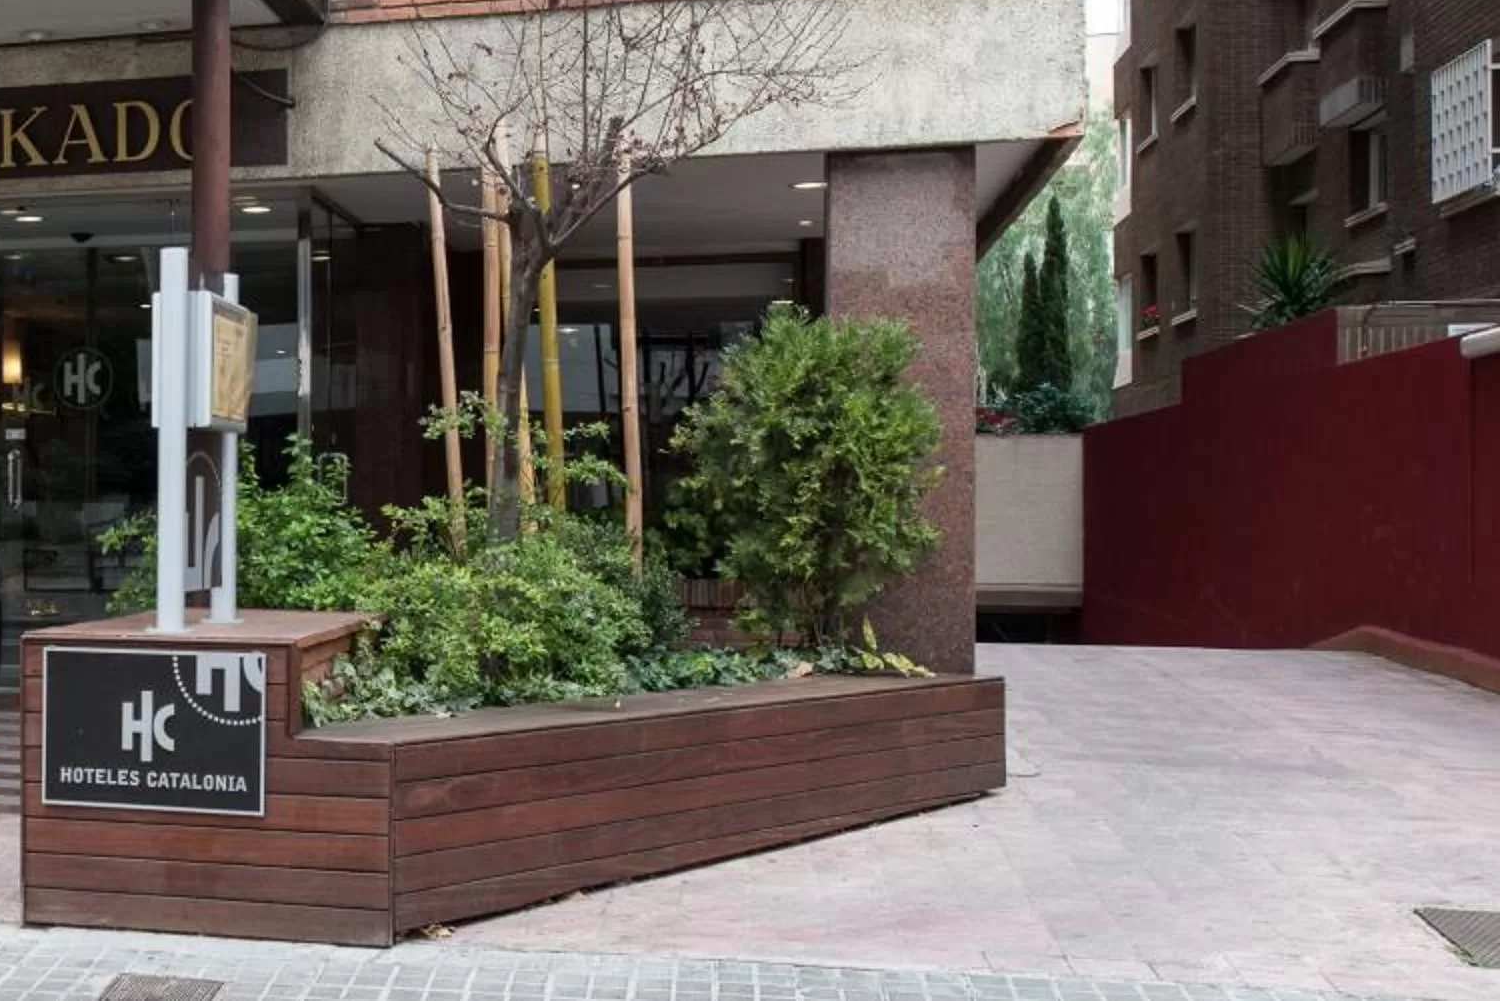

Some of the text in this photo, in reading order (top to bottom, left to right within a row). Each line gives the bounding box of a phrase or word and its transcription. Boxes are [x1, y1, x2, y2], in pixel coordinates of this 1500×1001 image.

[63, 353, 102, 404] HC
[121, 690, 175, 762] HC
[60, 766, 247, 792] HOTELES CATALONIA
